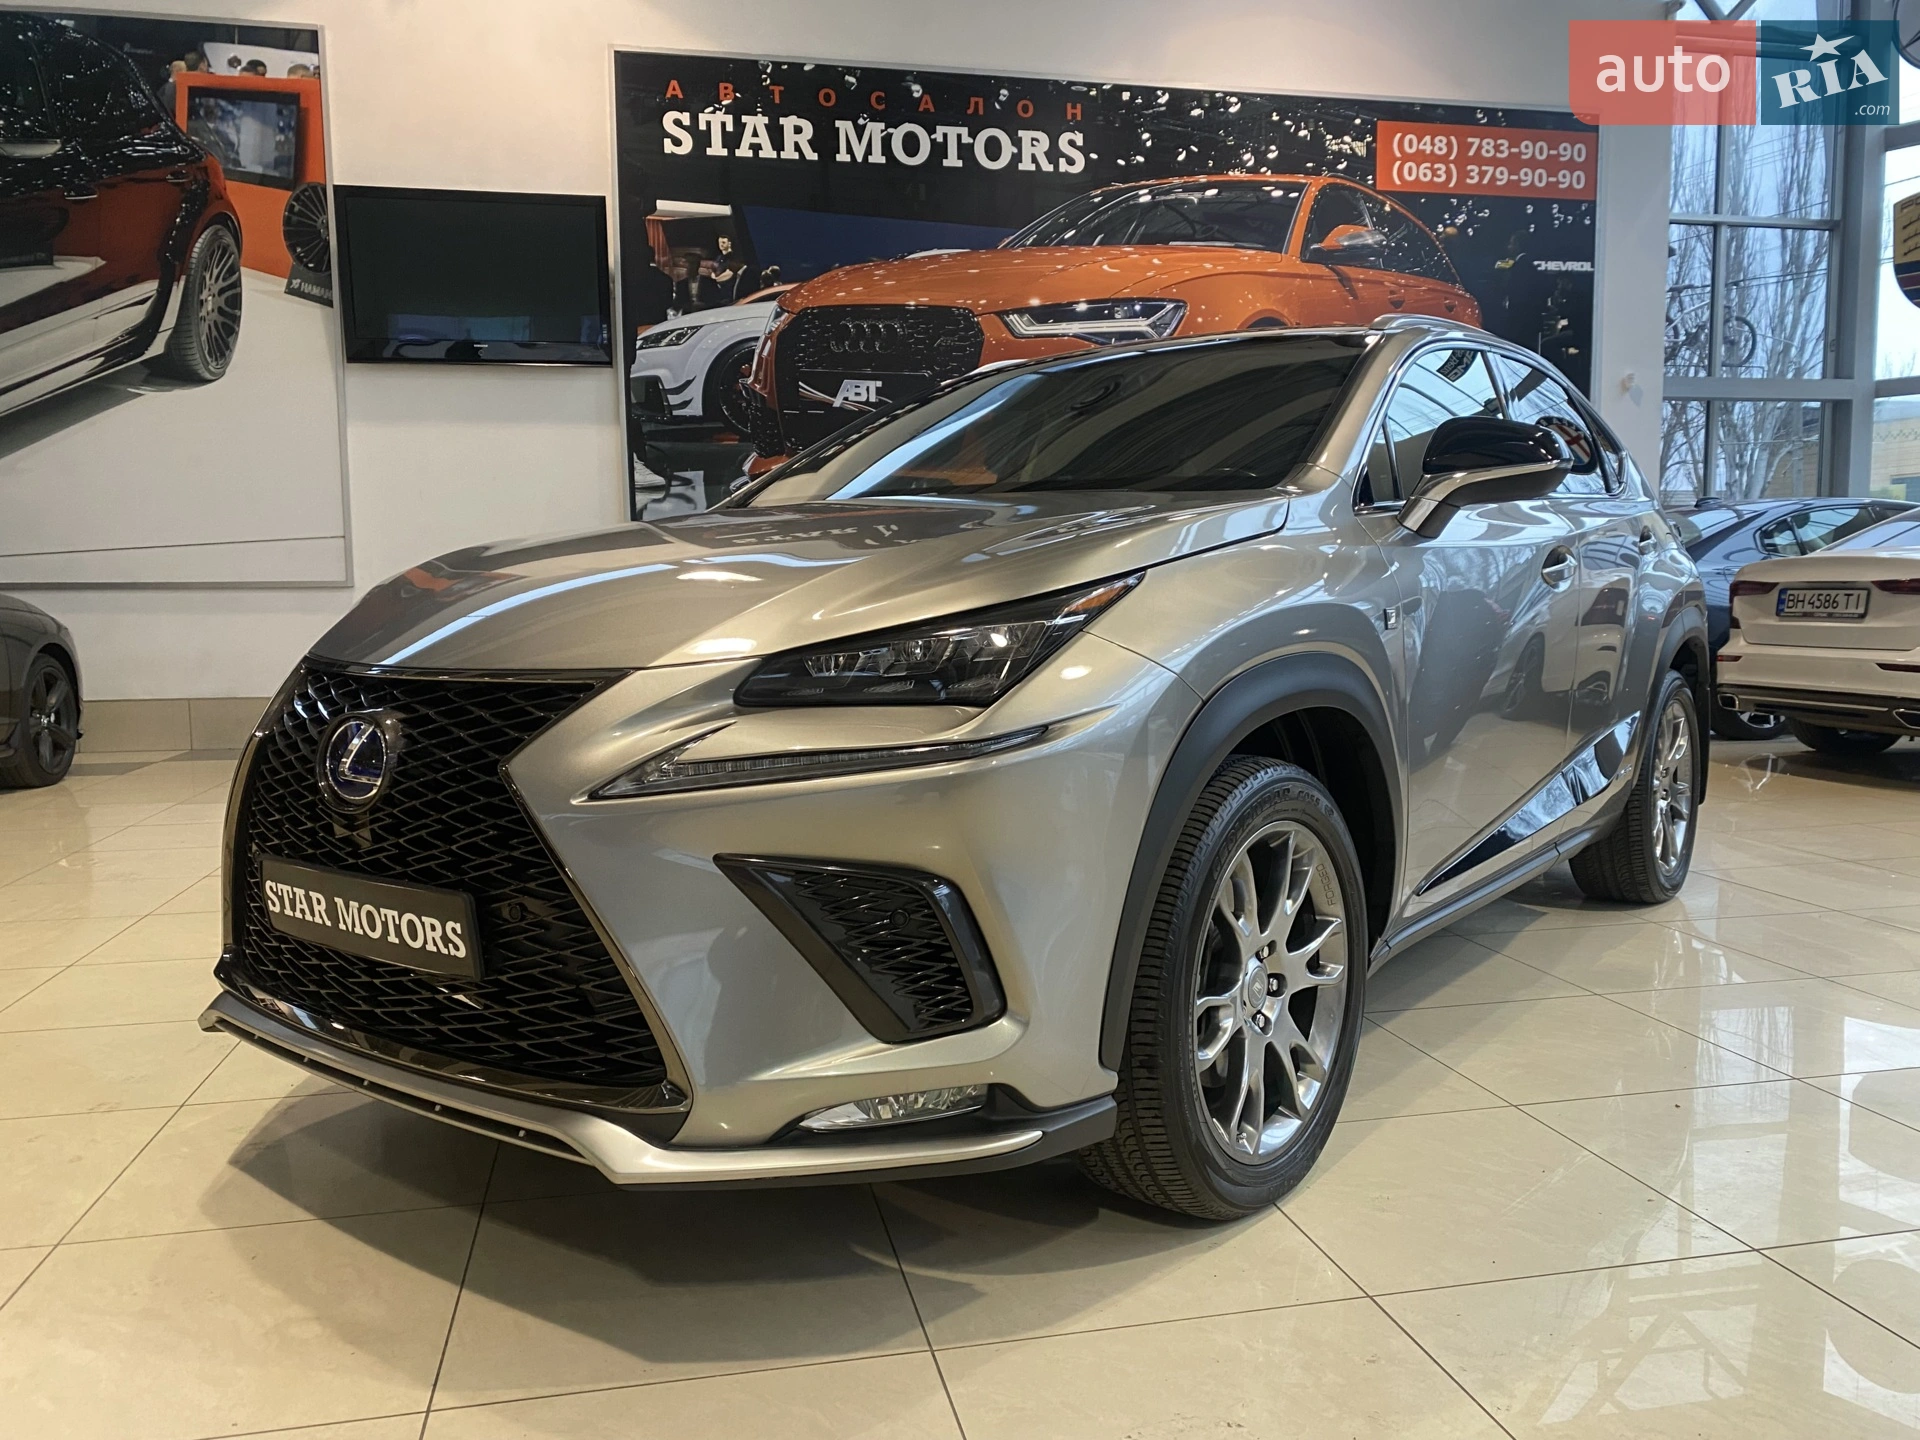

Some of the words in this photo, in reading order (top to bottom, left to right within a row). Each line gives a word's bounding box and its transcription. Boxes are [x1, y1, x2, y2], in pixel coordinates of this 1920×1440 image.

[664, 79, 1083, 122] АВТОСАЛОН
[661, 110, 819, 161] STAR
[834, 118, 1086, 174] MOTORS
[1392, 132, 1458, 160] (048)
[1465, 137, 1587, 163] 783-90-90
[1392, 160, 1458, 188] (063)
[1465, 164, 1587, 190] 379-90-90
[832, 379, 883, 408] ABT
[1807, 593, 1840, 610] 4586
[1315, 863, 1336, 907] FORGED
[264, 879, 332, 927] STAR
[334, 896, 467, 959] MOTORS
